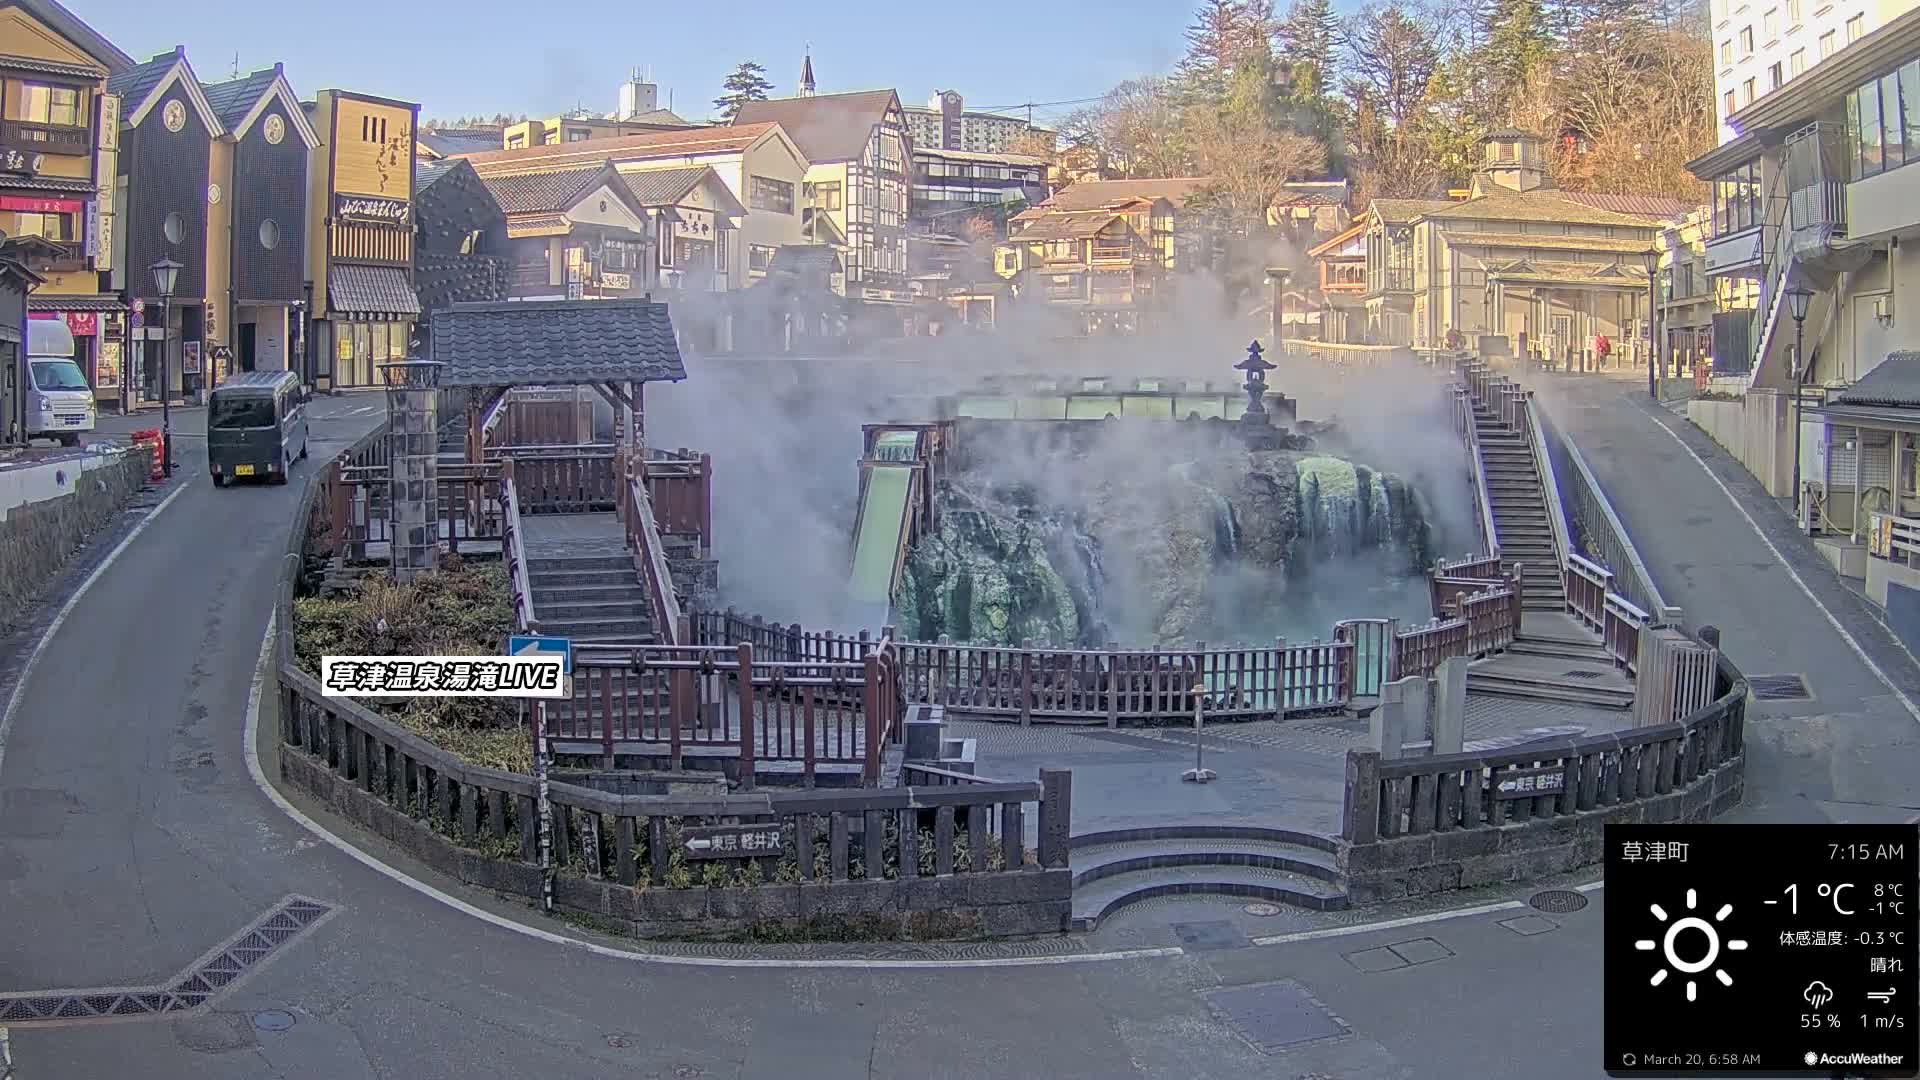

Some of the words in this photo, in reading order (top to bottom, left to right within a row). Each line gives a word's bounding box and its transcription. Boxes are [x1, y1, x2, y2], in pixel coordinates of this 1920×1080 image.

[711, 834, 738, 851] 東京
[740, 831, 781, 850] 軽井沢
